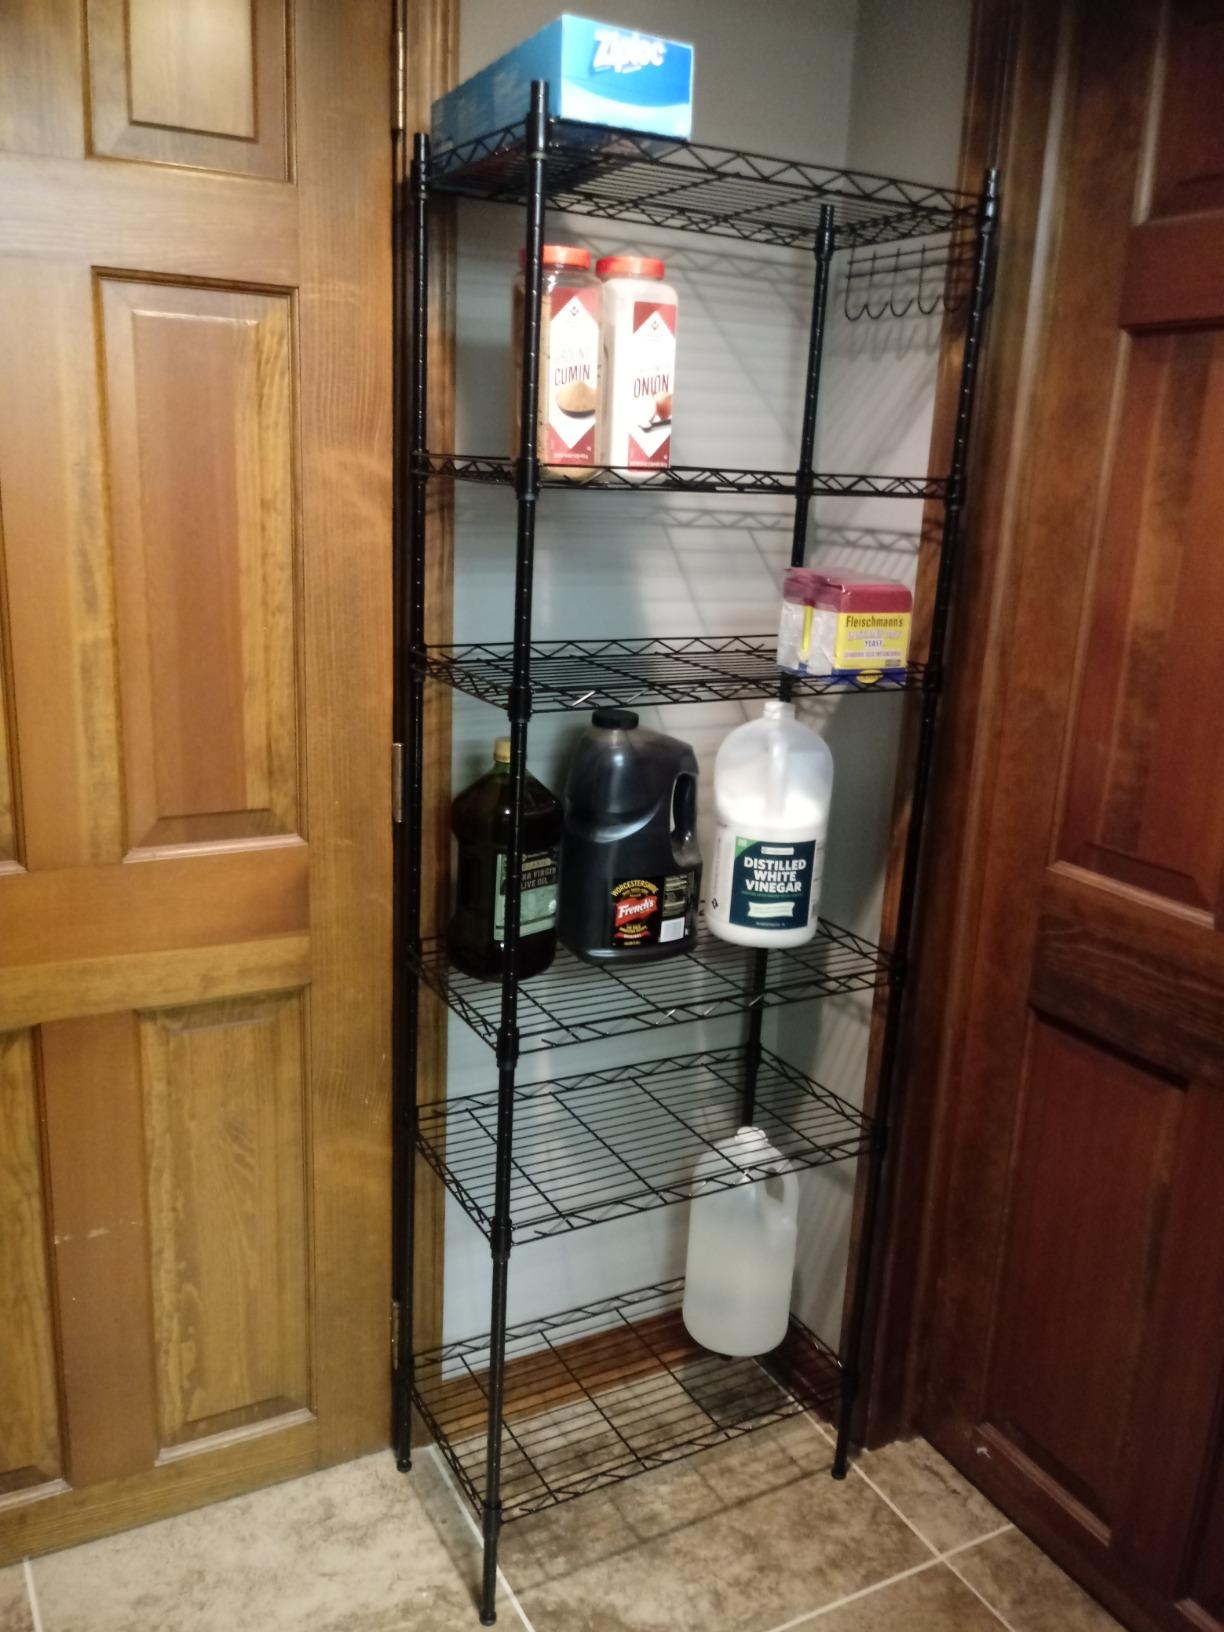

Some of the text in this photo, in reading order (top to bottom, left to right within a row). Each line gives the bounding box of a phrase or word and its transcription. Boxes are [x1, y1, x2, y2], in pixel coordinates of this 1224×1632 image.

[554, 364, 590, 386] CUMIN
[633, 373, 670, 398] ONION
[846, 615, 903, 628] Fleischmann's
[743, 856, 807, 871] DISTILLED
[753, 869, 797, 882] WHITE
[745, 879, 802, 893] VINEGAR
[618, 898, 655, 919] French's
